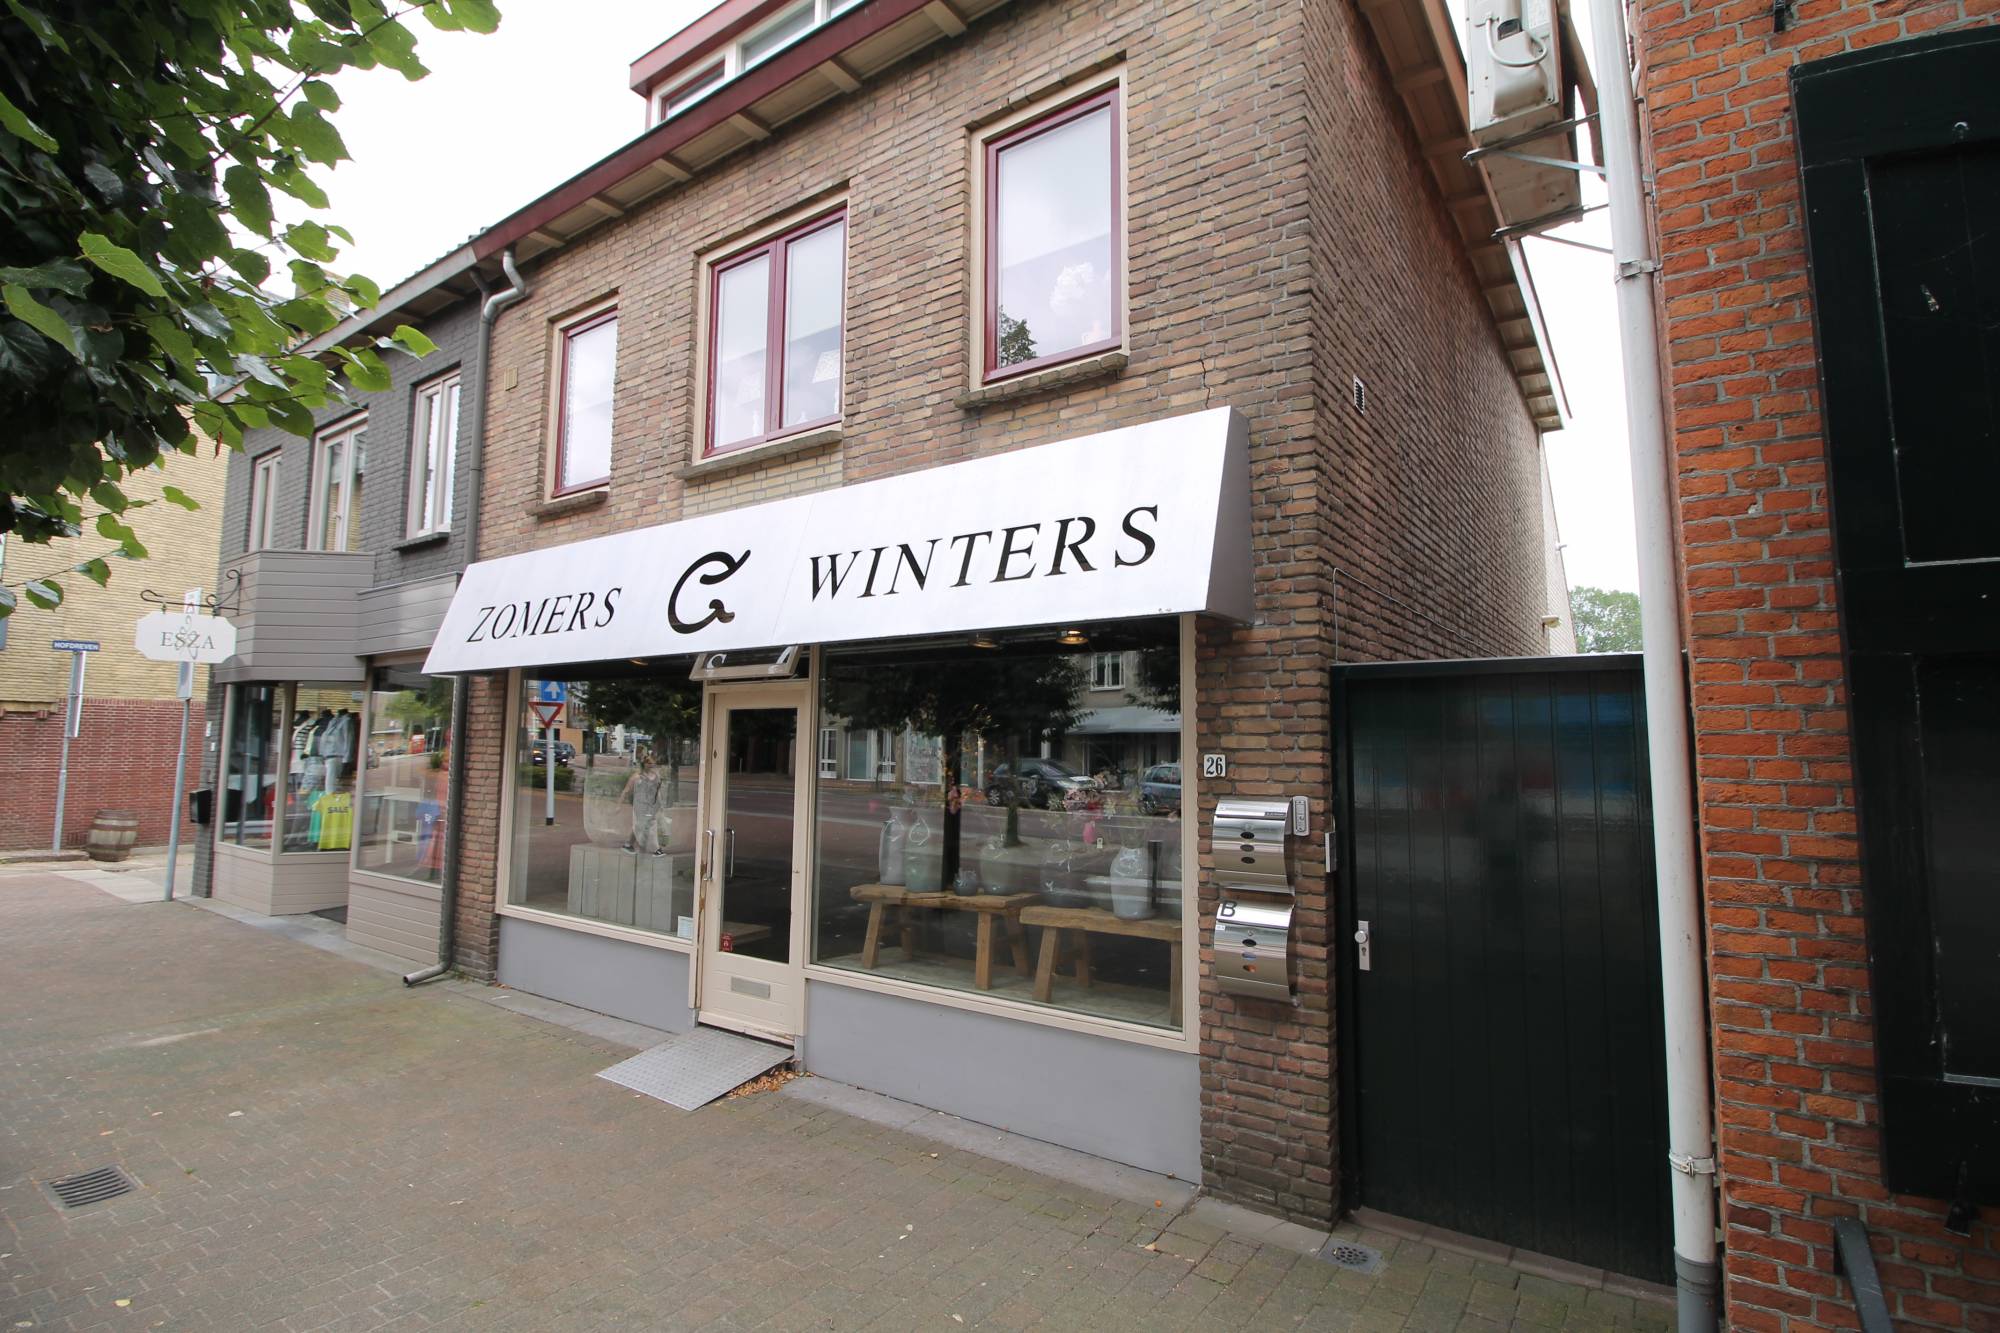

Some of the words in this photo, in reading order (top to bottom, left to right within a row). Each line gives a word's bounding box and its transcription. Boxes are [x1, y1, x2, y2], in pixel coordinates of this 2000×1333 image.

[467, 587, 622, 641] ZOMERS
[810, 504, 1158, 602] WINTERS
[1206, 756, 1223, 777] 26
[1220, 899, 1238, 917] B
